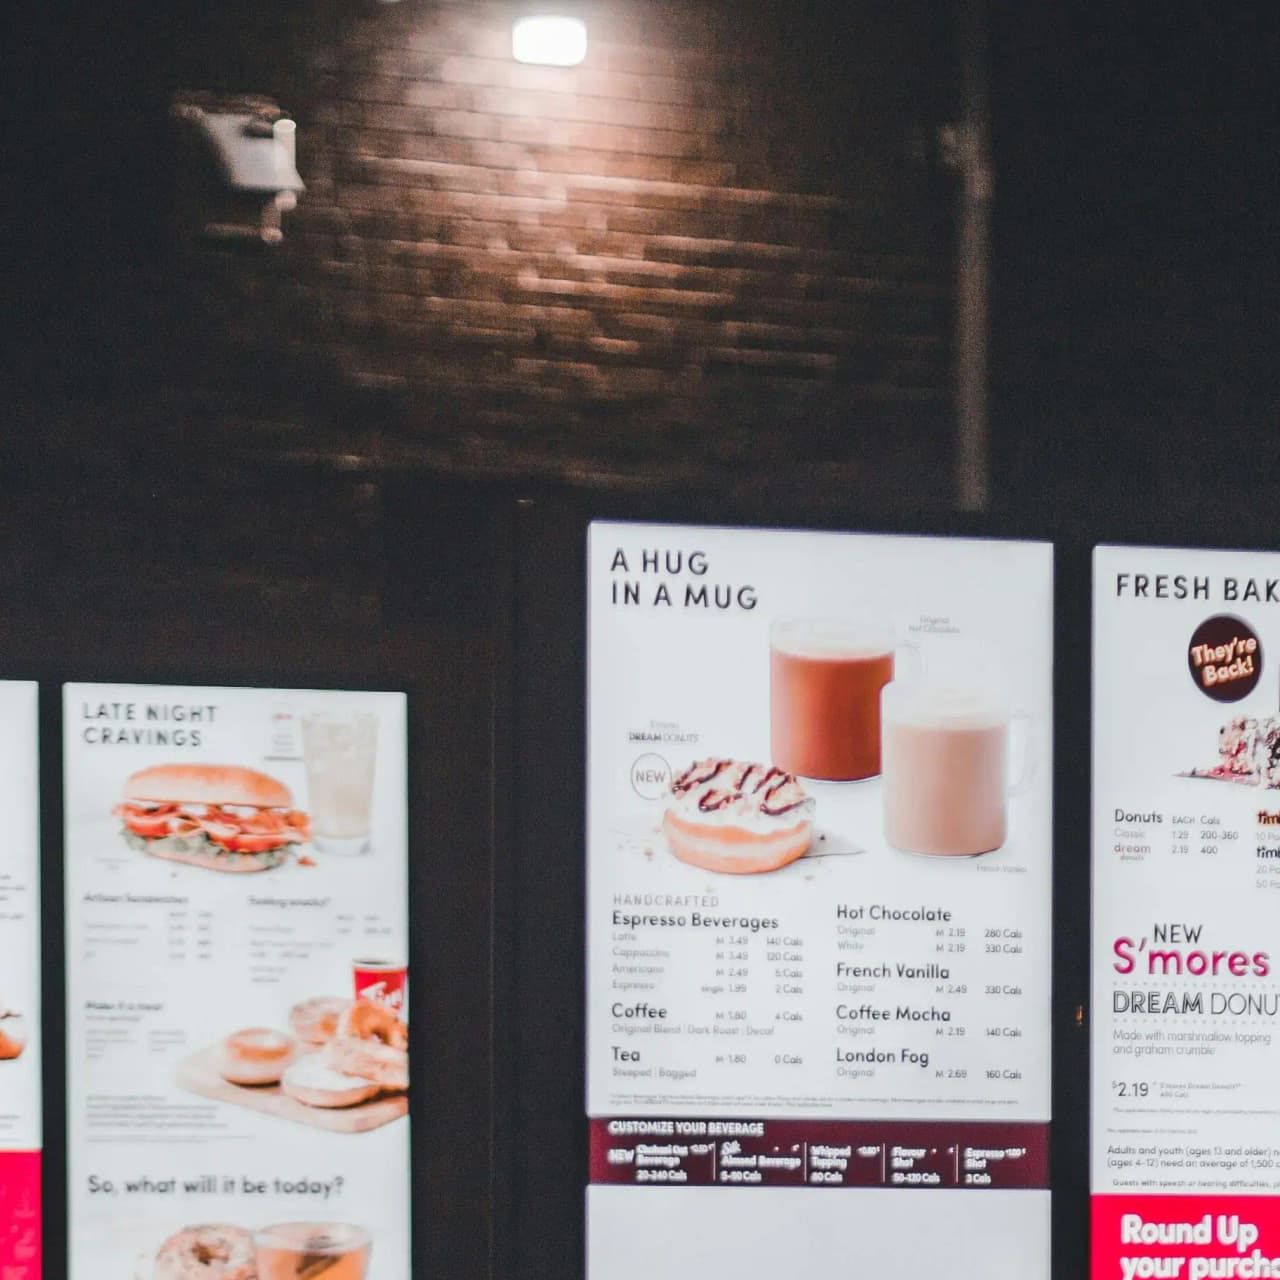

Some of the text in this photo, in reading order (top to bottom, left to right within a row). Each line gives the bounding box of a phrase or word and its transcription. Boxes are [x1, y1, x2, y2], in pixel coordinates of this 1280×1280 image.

[610, 548, 709, 575] A HUG
[611, 581, 759, 610] IN A MUG
[1117, 574, 1210, 600] FRESH
[1191, 636, 1257, 668] They're
[1202, 659, 1254, 687] Back!
[83, 703, 217, 723] LATE NIGHT
[83, 727, 202, 747] CRAVINGS
[636, 770, 665, 783] NEW
[1115, 808, 1163, 823] Donuts
[613, 895, 719, 907] HANDCRAFTED
[613, 910, 779, 932] Espresso Beverages
[837, 905, 952, 922] Hot Chocolate
[1153, 924, 1202, 943] NEW
[1113, 936, 1270, 977] S'mores
[837, 962, 950, 980] French Vanilla
[612, 1003, 667, 1019] Coffee
[1113, 990, 1203, 1015] DREAM
[836, 1005, 951, 1021] Coffee Mocha
[1113, 1029, 1271, 1045] Made with marshmallow topping
[612, 1046, 640, 1062] Tea
[836, 1048, 929, 1068] London Fog
[1113, 1044, 1216, 1057] and graham crumble
[608, 1121, 764, 1137] CUSTOMIZE YOUR BEVERAGE
[88, 1176, 345, 1199] So, what will it be today?
[1120, 1214, 1259, 1253] Round Up
